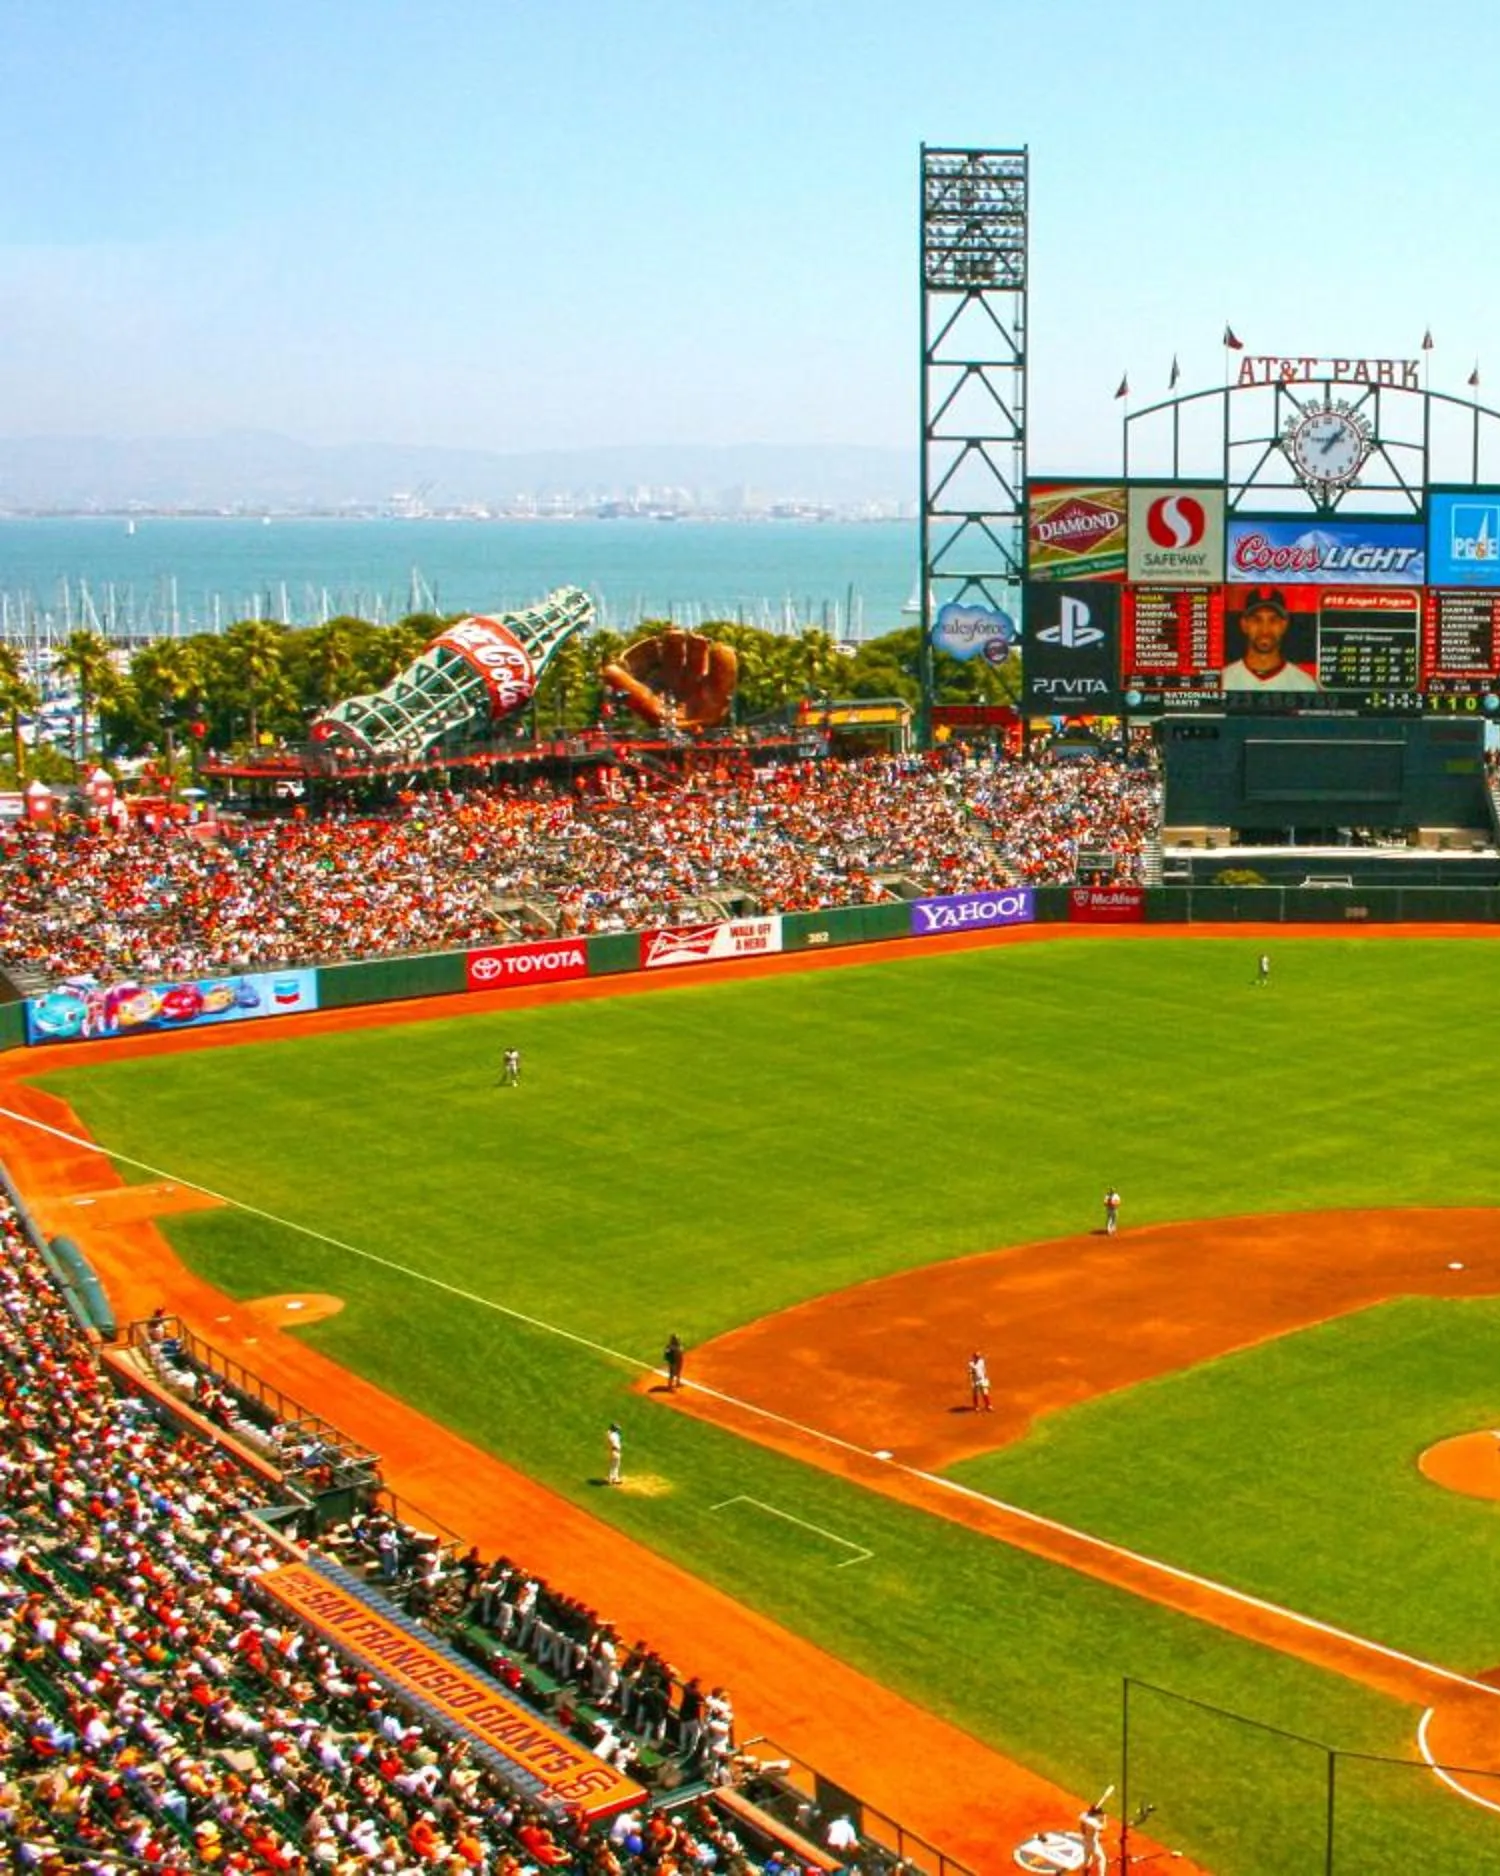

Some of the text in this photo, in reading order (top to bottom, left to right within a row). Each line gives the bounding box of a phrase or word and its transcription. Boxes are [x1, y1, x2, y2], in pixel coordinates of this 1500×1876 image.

[1238, 356, 1420, 389] AT&T PARK
[1037, 511, 1119, 541] DIAMOND
[1235, 533, 1417, 573] Coors LIGHT
[1454, 537, 1499, 561] PG&E
[1143, 553, 1207, 567] SAFEWAY
[1164, 691, 1219, 699] NATIONALS
[1164, 699, 1200, 707] GIANTS
[1465, 697, 1477, 711] 0
[1091, 893, 1139, 904] McAfee
[917, 892, 1028, 931] YAHOO!
[730, 924, 754, 937] WALK
[744, 937, 767, 949] HERO
[504, 950, 584, 973] TOYOTA
[300, 1591, 366, 1624] SAN
[340, 1620, 487, 1708] FRANCISCO
[464, 1704, 586, 1775] GIANTS
